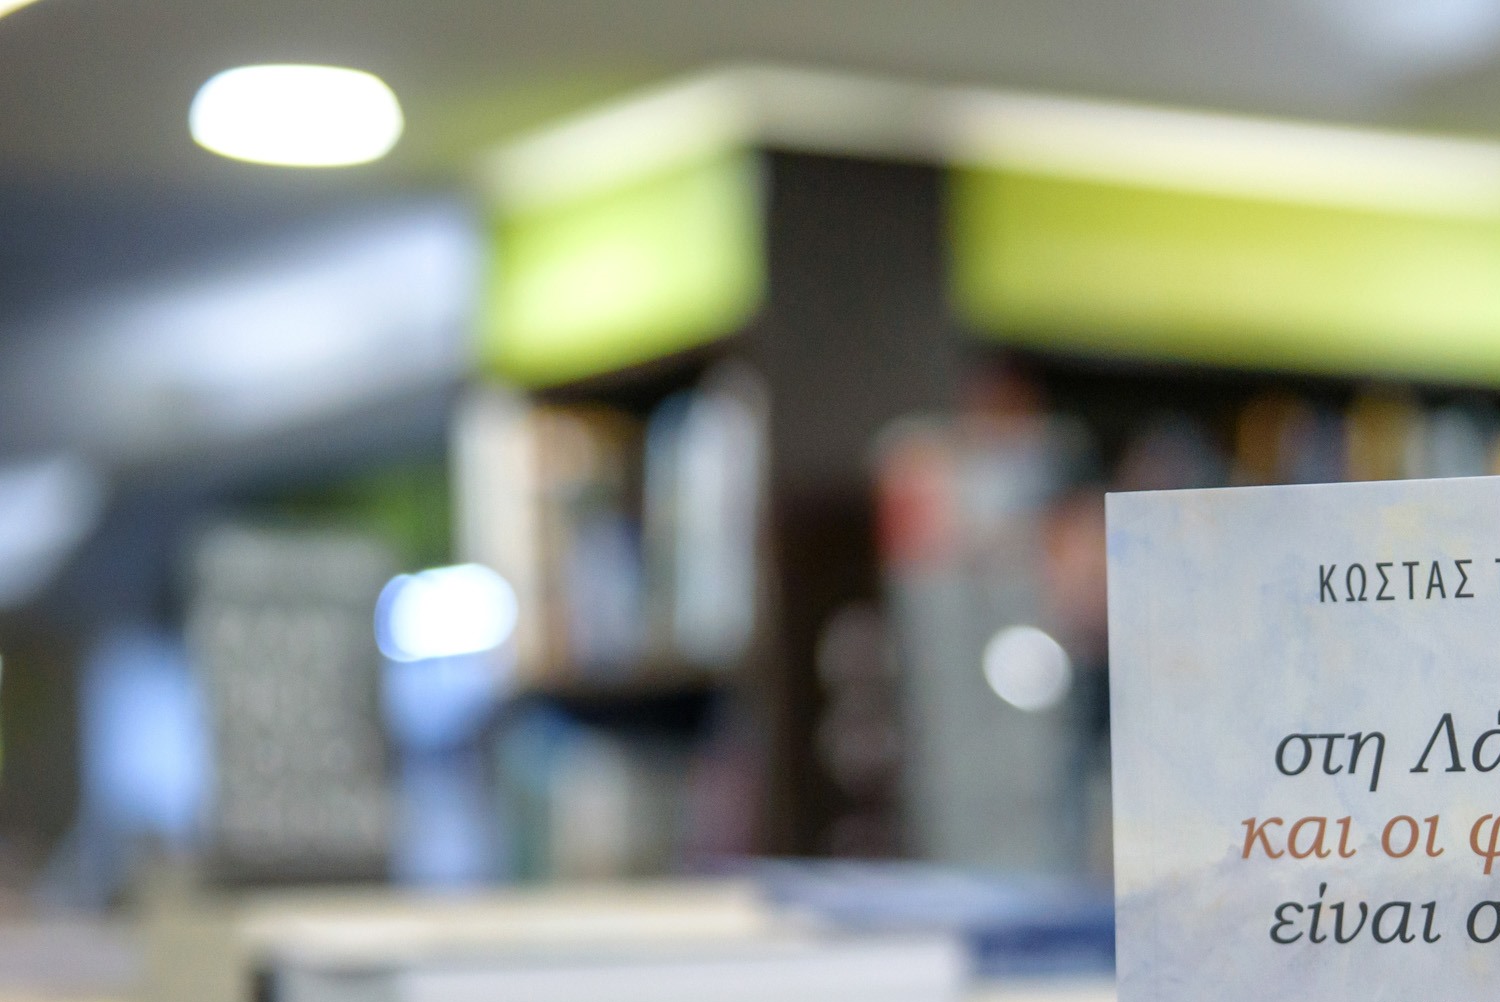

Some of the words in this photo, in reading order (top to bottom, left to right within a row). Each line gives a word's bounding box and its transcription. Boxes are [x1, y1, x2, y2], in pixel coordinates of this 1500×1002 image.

[1318, 557, 1475, 603] ΚΩΣΤΑΣ
[1273, 730, 1387, 792] στη
[1240, 814, 1357, 860] και
[1380, 813, 1445, 858] οι
[1268, 882, 1442, 944] είναι
